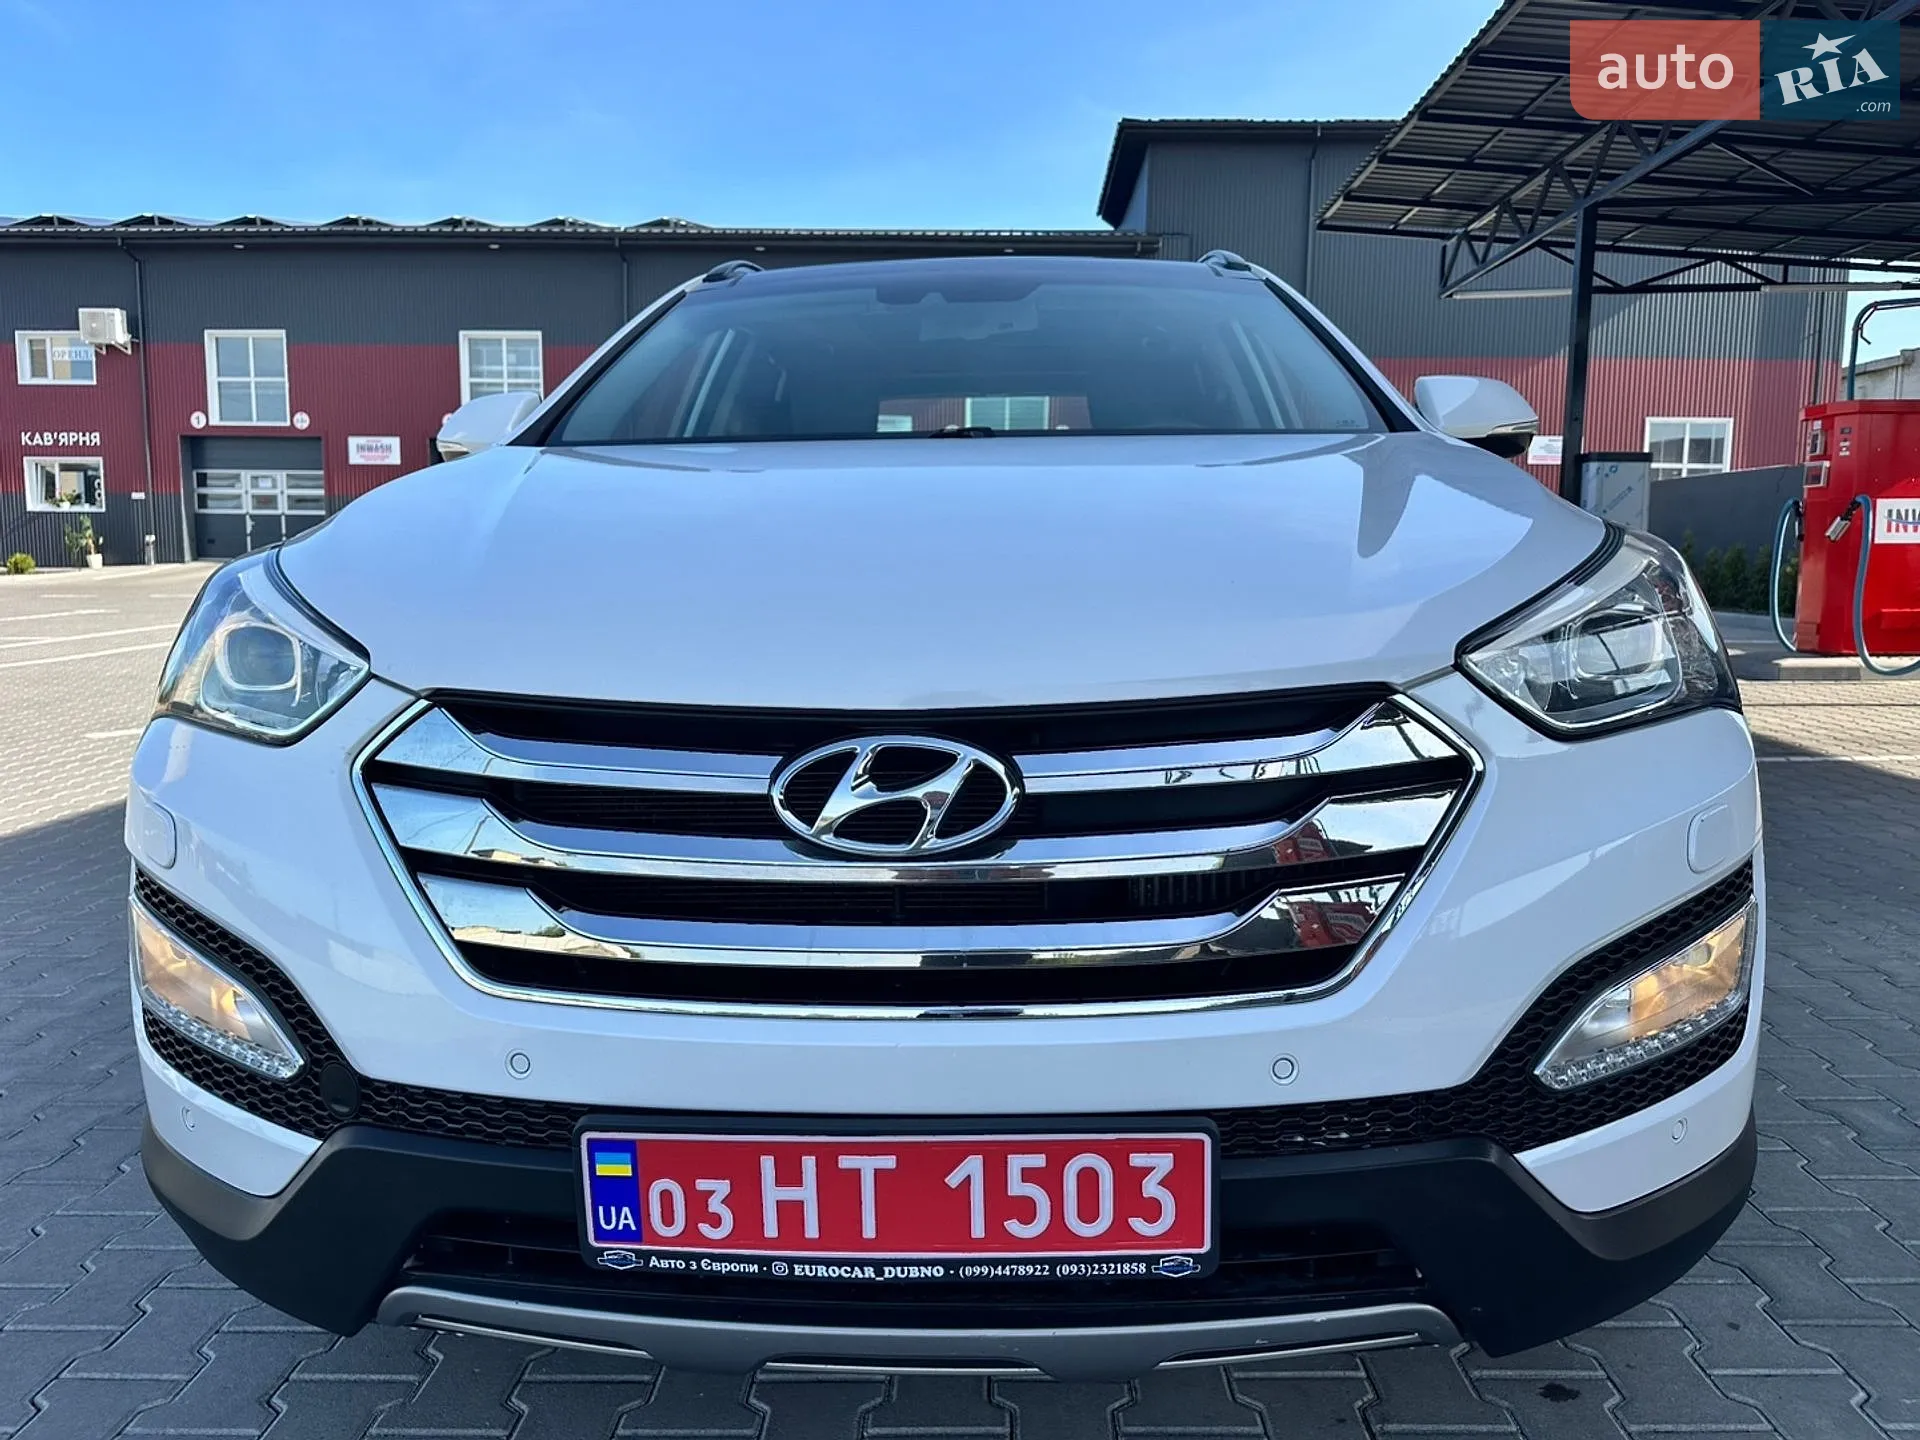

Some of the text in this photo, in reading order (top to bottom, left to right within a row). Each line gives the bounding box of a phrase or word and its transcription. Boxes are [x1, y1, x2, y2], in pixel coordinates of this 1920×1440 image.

[21, 431, 101, 446] КАВ'ЯРНЯ
[648, 1178, 734, 1240] 03
[944, 1152, 1176, 1239] 1503
[598, 1205, 637, 1231] UA
[649, 1255, 686, 1270] Авто
[700, 1258, 759, 1275] Європи
[793, 1263, 945, 1281] EUROCAR_DUBNO
[958, 1264, 1050, 1279] (099)4478922
[1055, 1262, 1147, 1278] (093)2321858
